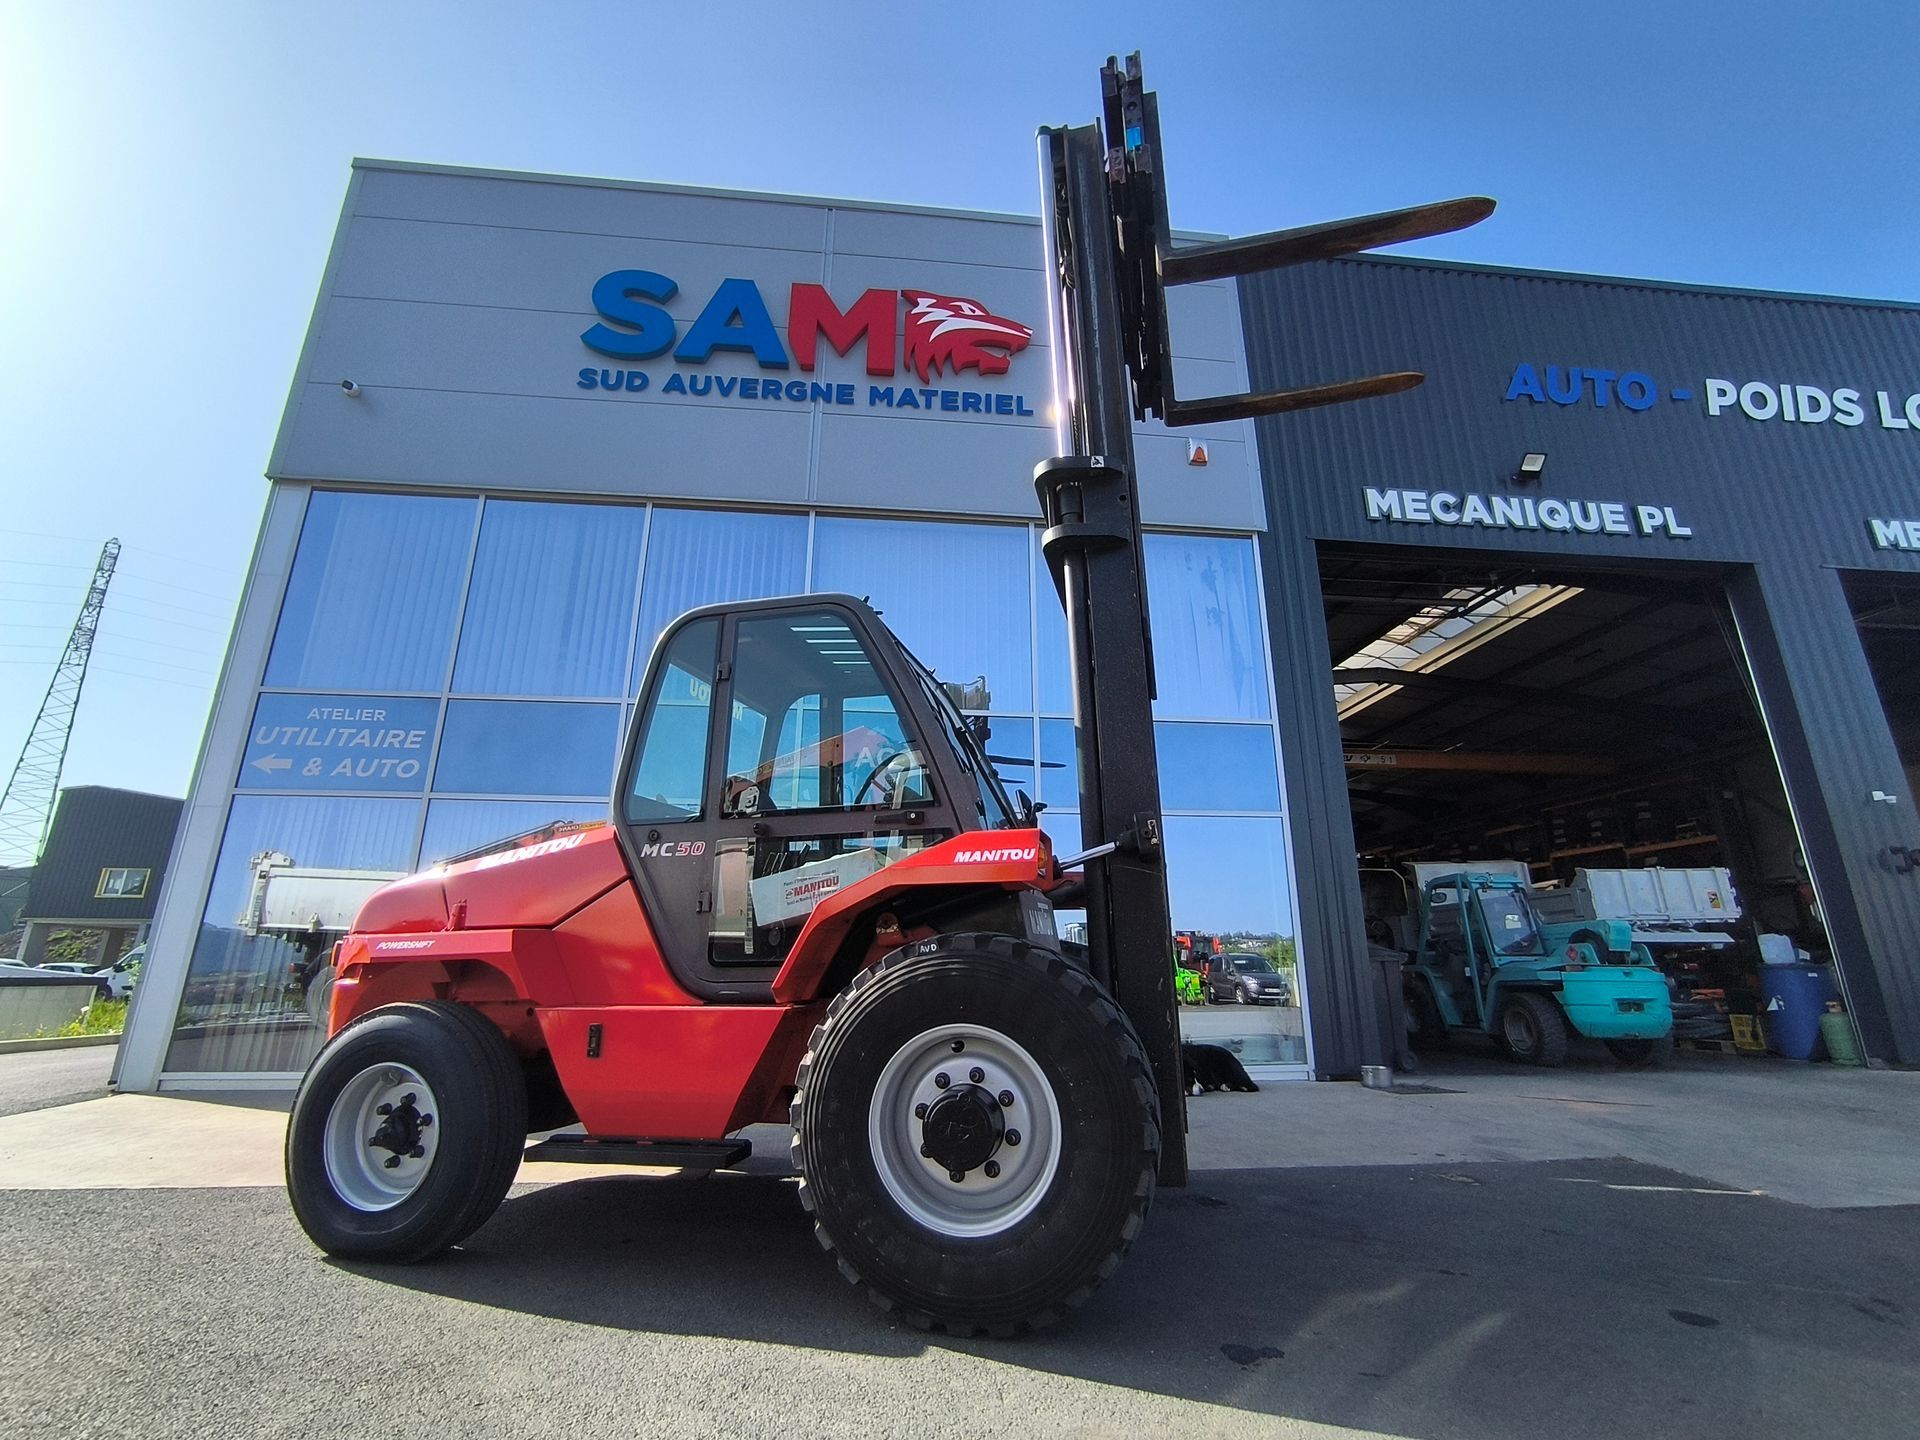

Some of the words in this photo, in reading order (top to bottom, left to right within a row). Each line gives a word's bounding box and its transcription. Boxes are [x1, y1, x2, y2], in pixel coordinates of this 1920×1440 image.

[580, 269, 897, 377] SAM
[577, 367, 649, 392] SUD
[662, 372, 855, 405] AUVERGNE
[868, 385, 1035, 417] MATERIEL
[1505, 362, 1658, 411] AUTO
[1705, 377, 1865, 427] POIDS
[1365, 486, 1631, 536] MECANIQUE
[1637, 504, 1693, 538] PL
[306, 707, 386, 722] ATELIER
[255, 726, 427, 749] UTILITAIRE
[302, 757, 323, 777] &
[330, 758, 420, 779] AUTO
[954, 847, 1036, 863] MANITOU
[794, 875, 840, 897] MANITOU
[376, 939, 436, 951] POWERSHIFT
